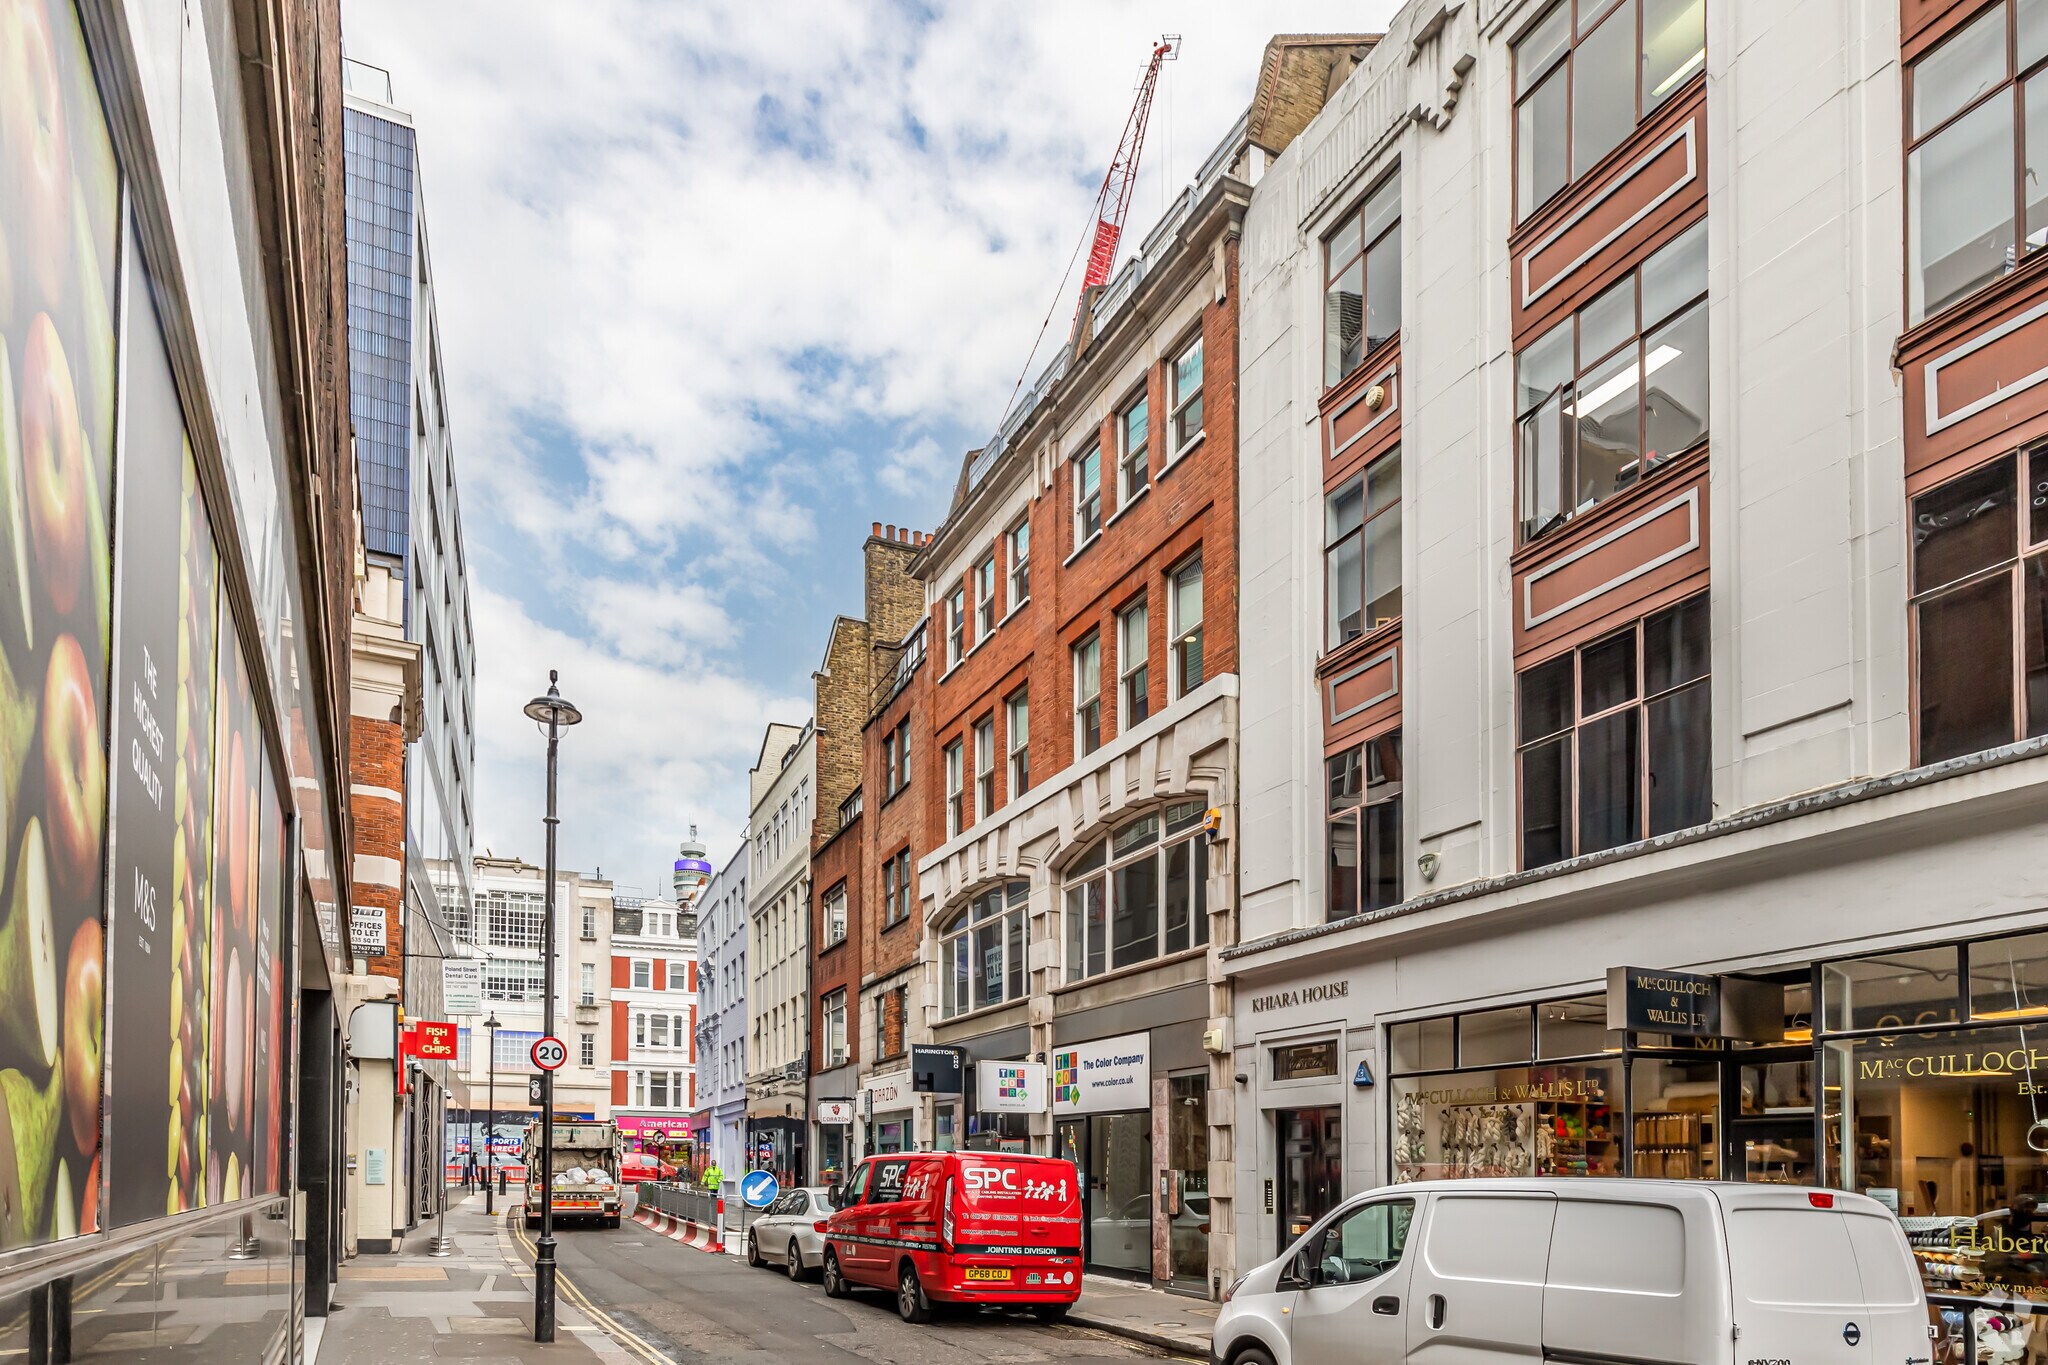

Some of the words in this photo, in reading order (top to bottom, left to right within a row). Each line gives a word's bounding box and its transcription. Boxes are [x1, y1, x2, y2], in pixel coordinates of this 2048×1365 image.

[143, 644, 157, 700] THE
[133, 680, 164, 763] HIGHEST
[132, 738, 163, 812] QUALITY
[134, 866, 156, 932] M&S
[364, 929, 380, 937] LET
[1252, 990, 1300, 1013] KHIARA
[1302, 980, 1348, 1004] HOUSE
[1670, 996, 1678, 1008] &
[1647, 1009, 1688, 1025] WALLIS
[426, 1027, 448, 1036] FISH
[432, 1036, 440, 1044] &
[422, 1044, 451, 1054] CHIPS
[538, 1046, 563, 1061] 20
[1056, 1052, 1078, 1070] THE
[1084, 1060, 1094, 1070] The
[1096, 1058, 1112, 1068] Color
[1114, 1054, 1144, 1066] Company
[1056, 1068, 1078, 1086] COL
[1092, 1075, 1134, 1088] www.color.co.uk
[1501, 1088, 1510, 1100] &
[1514, 1082, 1572, 1098] WALLIS
[2018, 1082, 2047, 1095] Est.
[640, 1120, 688, 1128] American
[880, 1164, 906, 1188] SPC
[964, 1168, 1016, 1190] SPC
[985, 1246, 1022, 1254] JOINTING
[968, 1270, 990, 1278] GP68
